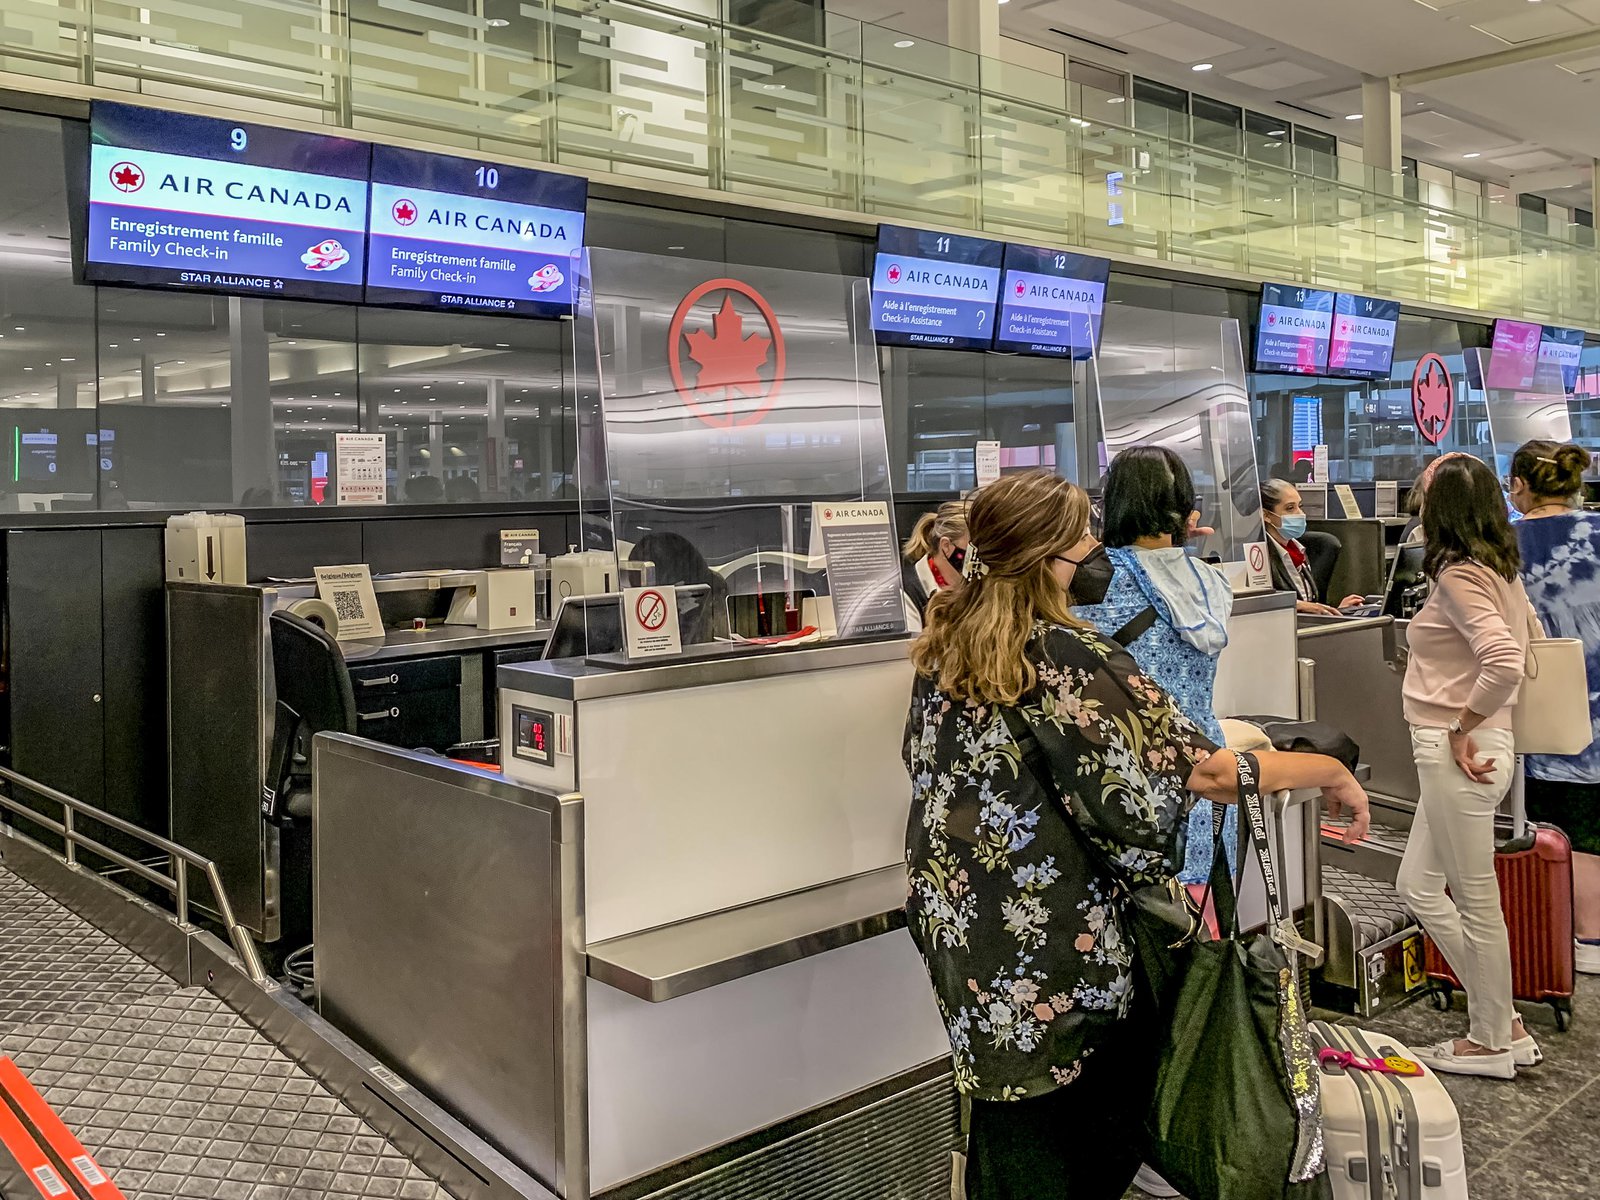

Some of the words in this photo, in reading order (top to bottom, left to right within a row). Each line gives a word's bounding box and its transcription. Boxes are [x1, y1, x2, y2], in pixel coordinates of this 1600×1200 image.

[231, 128, 247, 150] 9
[475, 167, 499, 188] 10
[160, 174, 214, 196] AIR
[225, 182, 352, 213] CANADA
[110, 217, 229, 242] Enregistrement
[233, 230, 283, 247] famille
[428, 209, 468, 228] AIR
[475, 215, 566, 240] CANADA
[110, 237, 160, 256] Family
[165, 242, 228, 260] Check-in
[936, 237, 950, 253] 11
[391, 248, 477, 267] Enregistrement
[480, 256, 516, 272] famille
[1054, 255, 1066, 270] 12
[181, 272, 211, 283] STAR
[214, 275, 270, 288] ALLIANCE
[391, 265, 428, 282] Family
[430, 269, 476, 284] Check-in
[907, 271, 930, 284] AIR
[934, 274, 988, 290] CANADA
[440, 295, 463, 304] STAR
[464, 297, 505, 308] ALLIANCE
[1030, 286, 1048, 297] AIR
[1052, 288, 1095, 303] CANADA
[1296, 291, 1305, 302] 13
[883, 300, 898, 310] Aide
[1365, 301, 1372, 312] 14
[882, 314, 910, 324] Check-in
[910, 316, 942, 326] Assistance
[1279, 316, 1292, 326] AIR
[1294, 318, 1326, 330] CANADA
[1009, 325, 1032, 334] Check-in
[1032, 326, 1058, 336] Assistance
[1350, 325, 1361, 333] AIR
[1363, 326, 1389, 337] CANADA
[851, 509, 884, 517] CANADA
[1245, 794, 1265, 840] PINK
[1259, 848, 1277, 896] PINK
